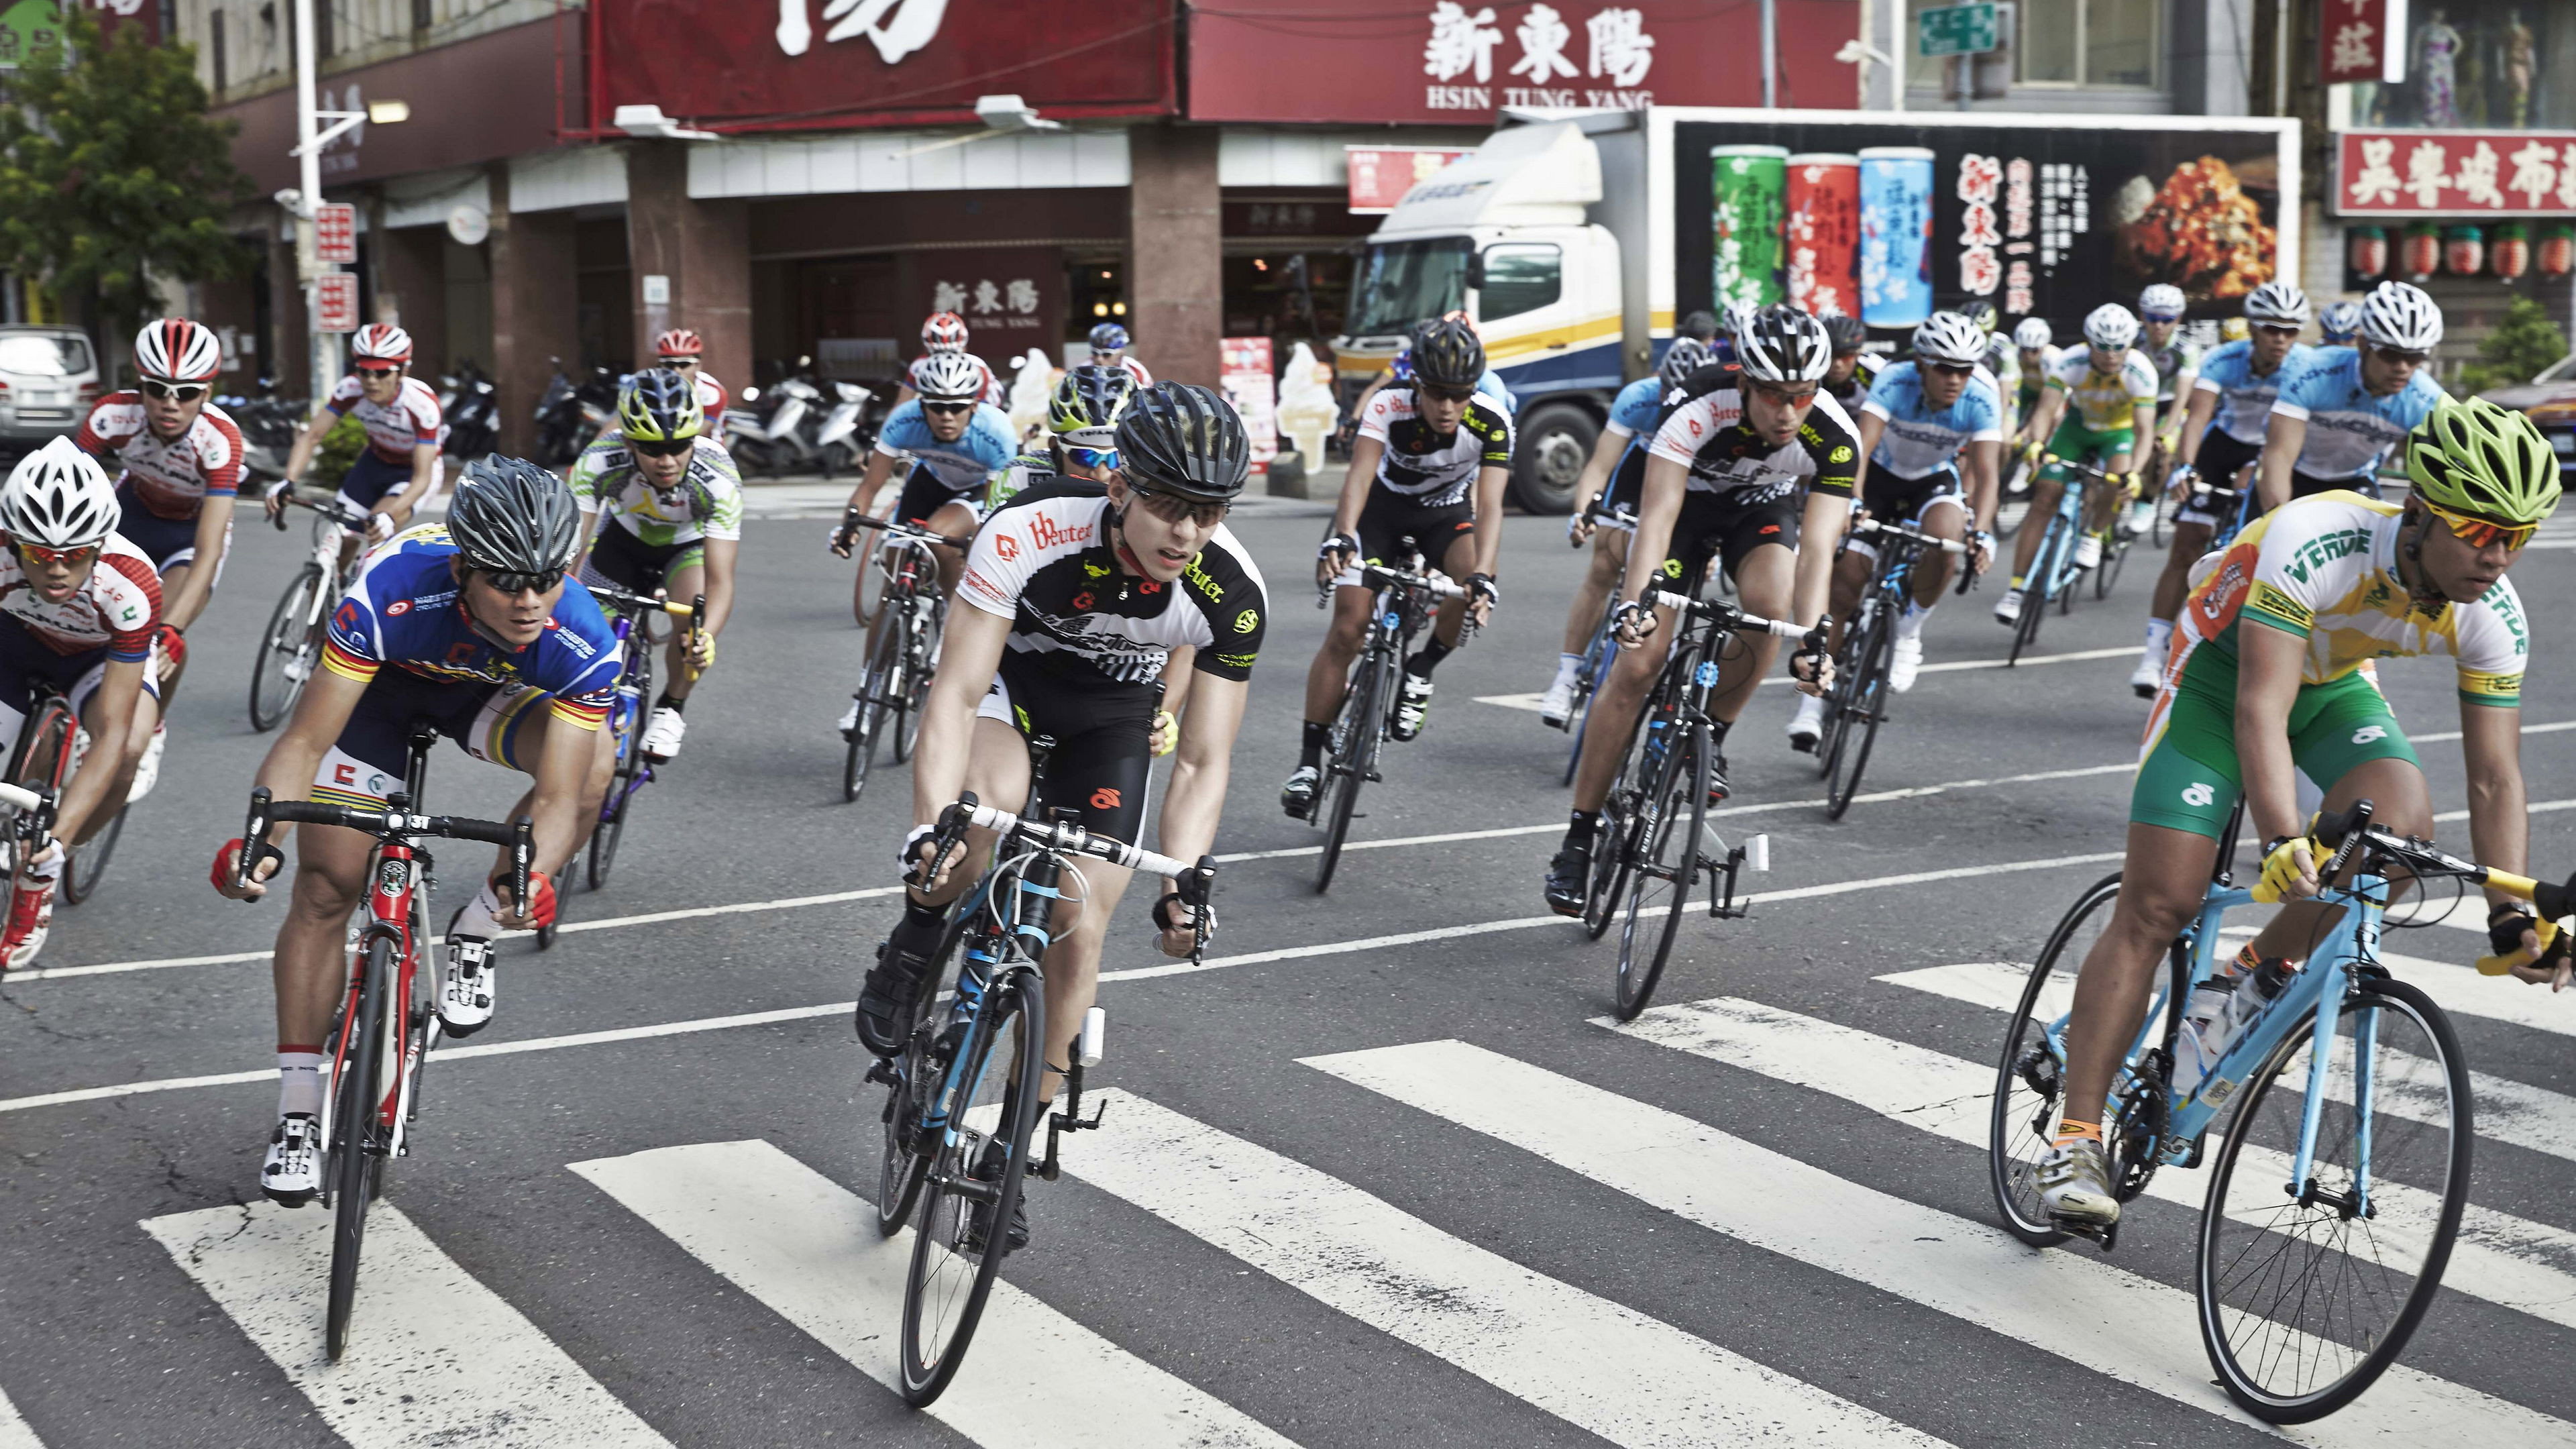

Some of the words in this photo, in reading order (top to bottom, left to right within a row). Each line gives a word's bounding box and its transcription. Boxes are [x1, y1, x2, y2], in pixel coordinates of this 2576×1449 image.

[1424, 1, 1656, 87] 新東陽
[2330, 0, 2377, 72] 莊
[1426, 86, 1491, 109] HSIN
[1502, 87, 1577, 108] TUNG
[1585, 89, 1654, 111] YANG
[1956, 153, 2004, 296] 新東陽
[2284, 527, 2373, 584] VERDE
[2479, 582, 2527, 655] ERDE
[411, 814, 431, 830] 3T
